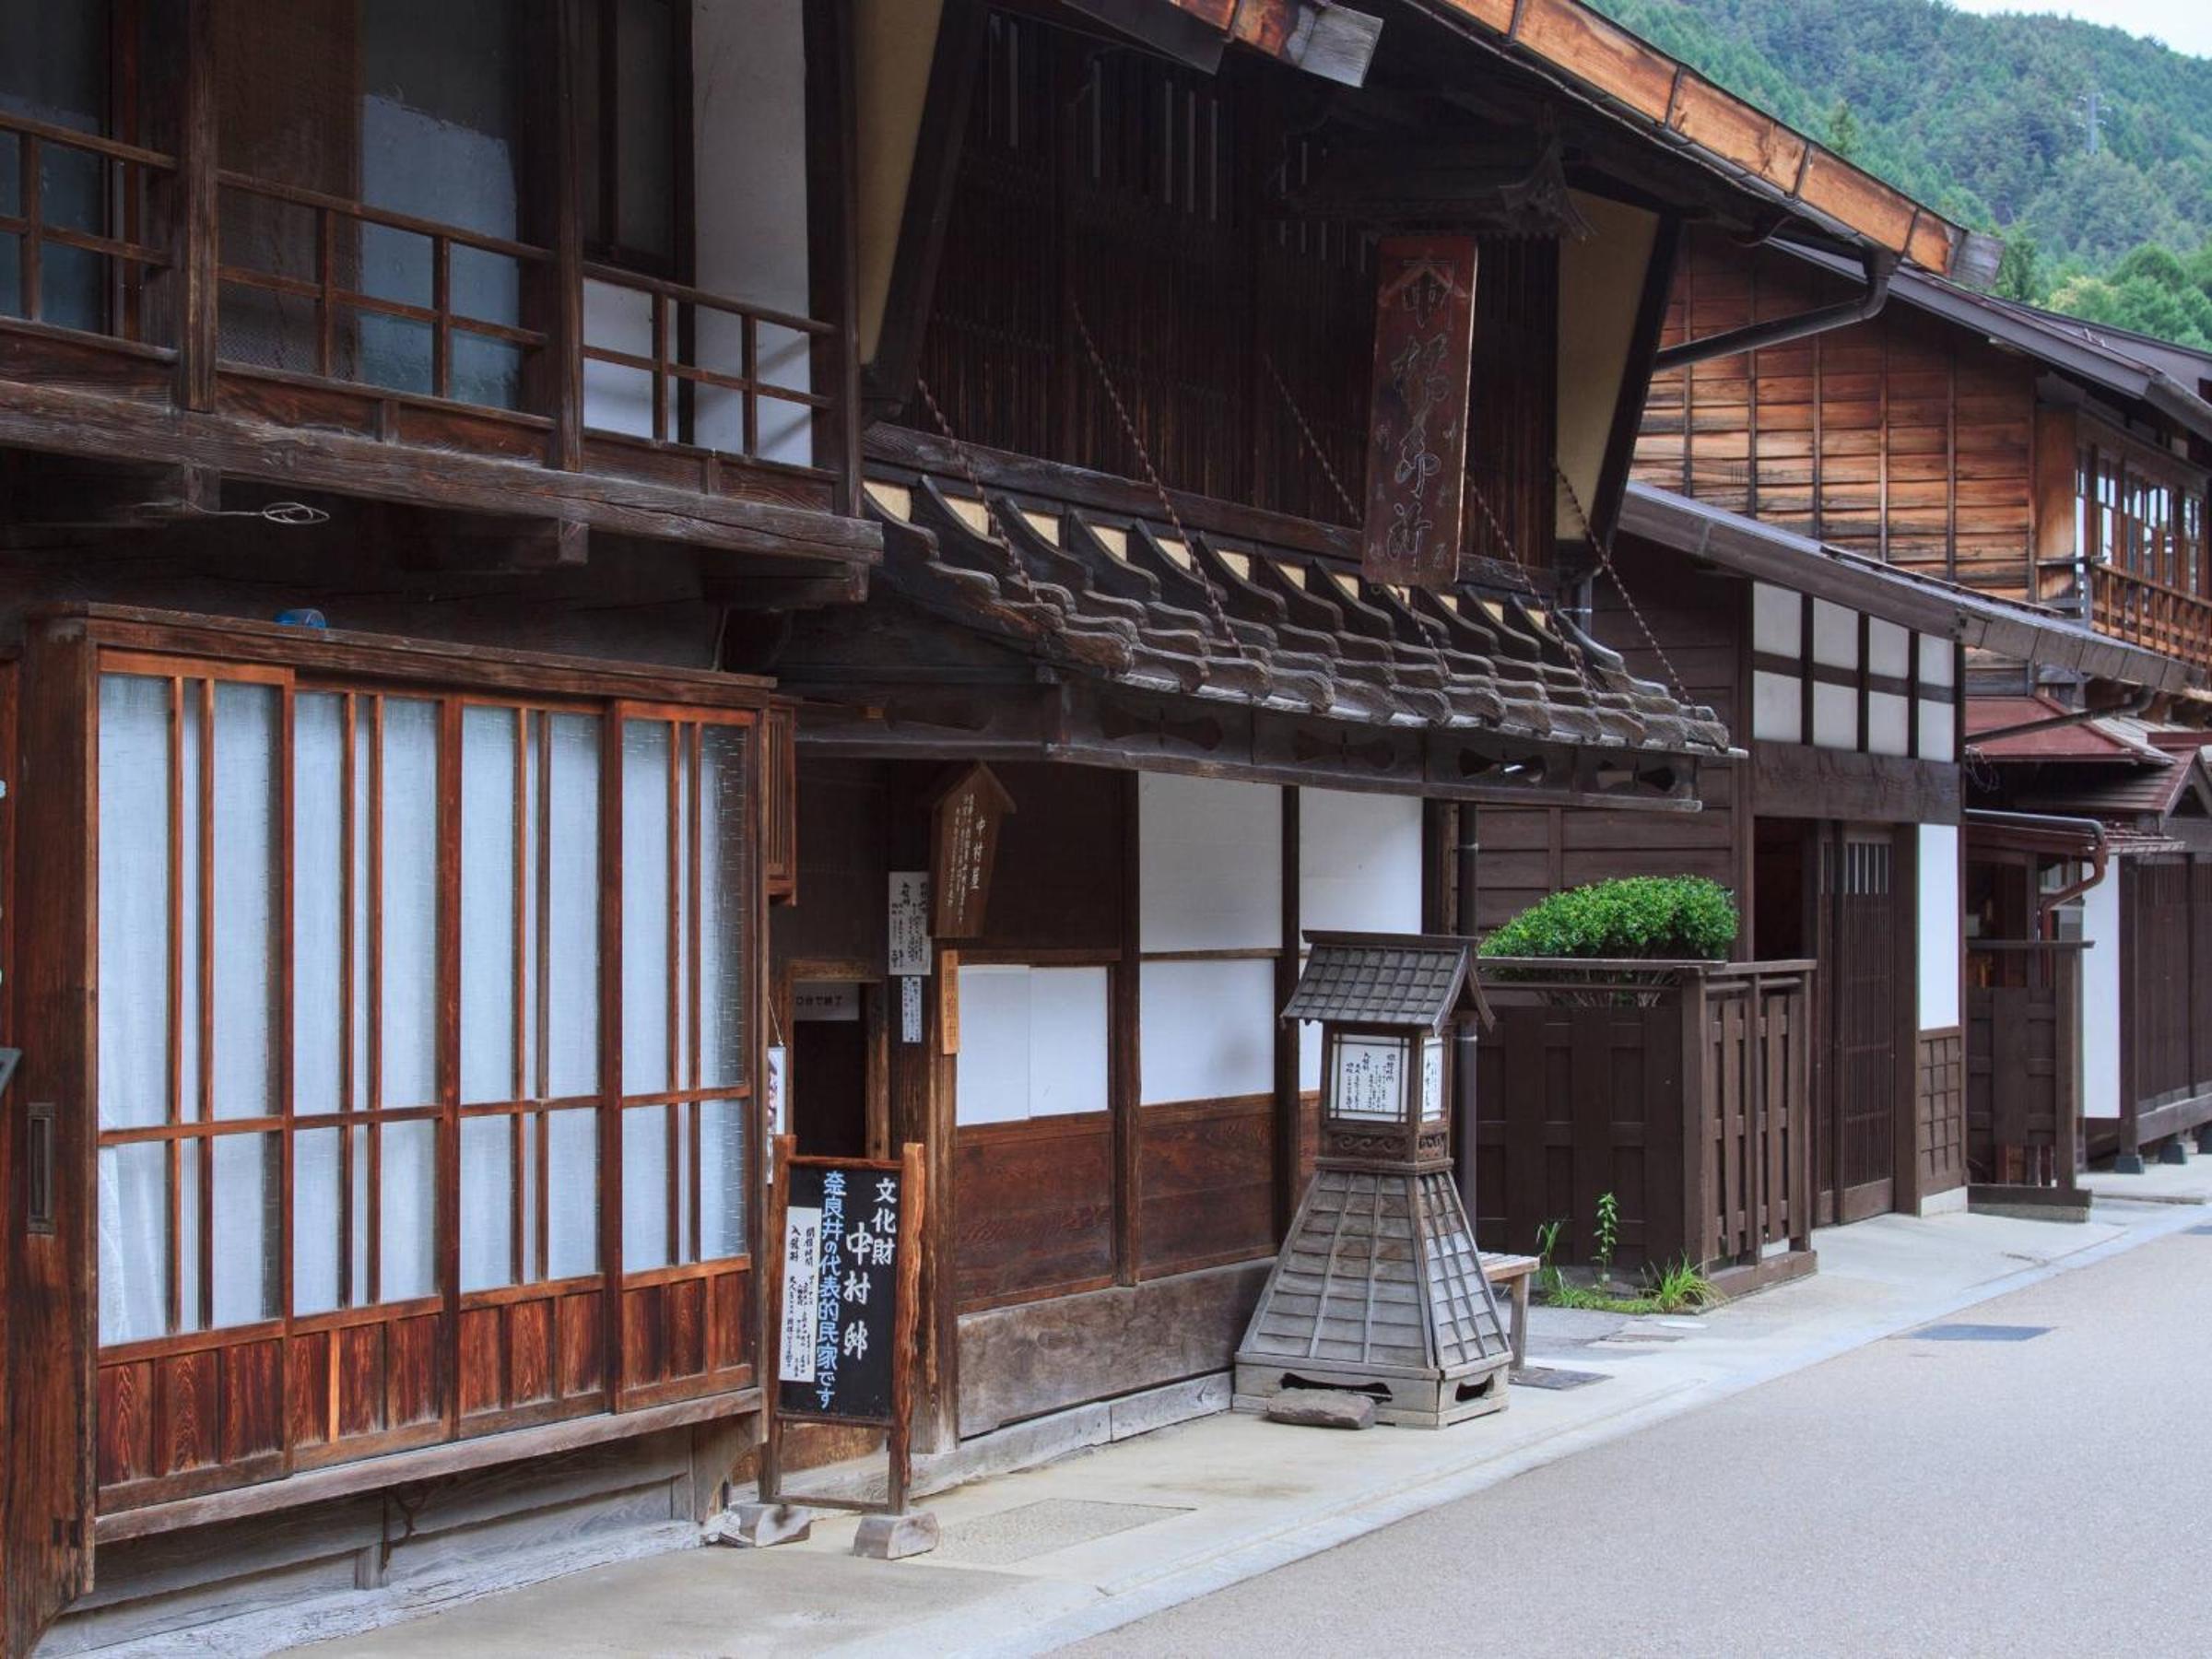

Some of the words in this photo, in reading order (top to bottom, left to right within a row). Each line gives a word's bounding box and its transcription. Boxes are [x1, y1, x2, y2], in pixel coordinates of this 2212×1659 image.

[816, 1171, 848, 1410] 奈良井の代表的民家です
[843, 1221, 875, 1361] 中村邸
[871, 1177, 899, 1266] 文化財
